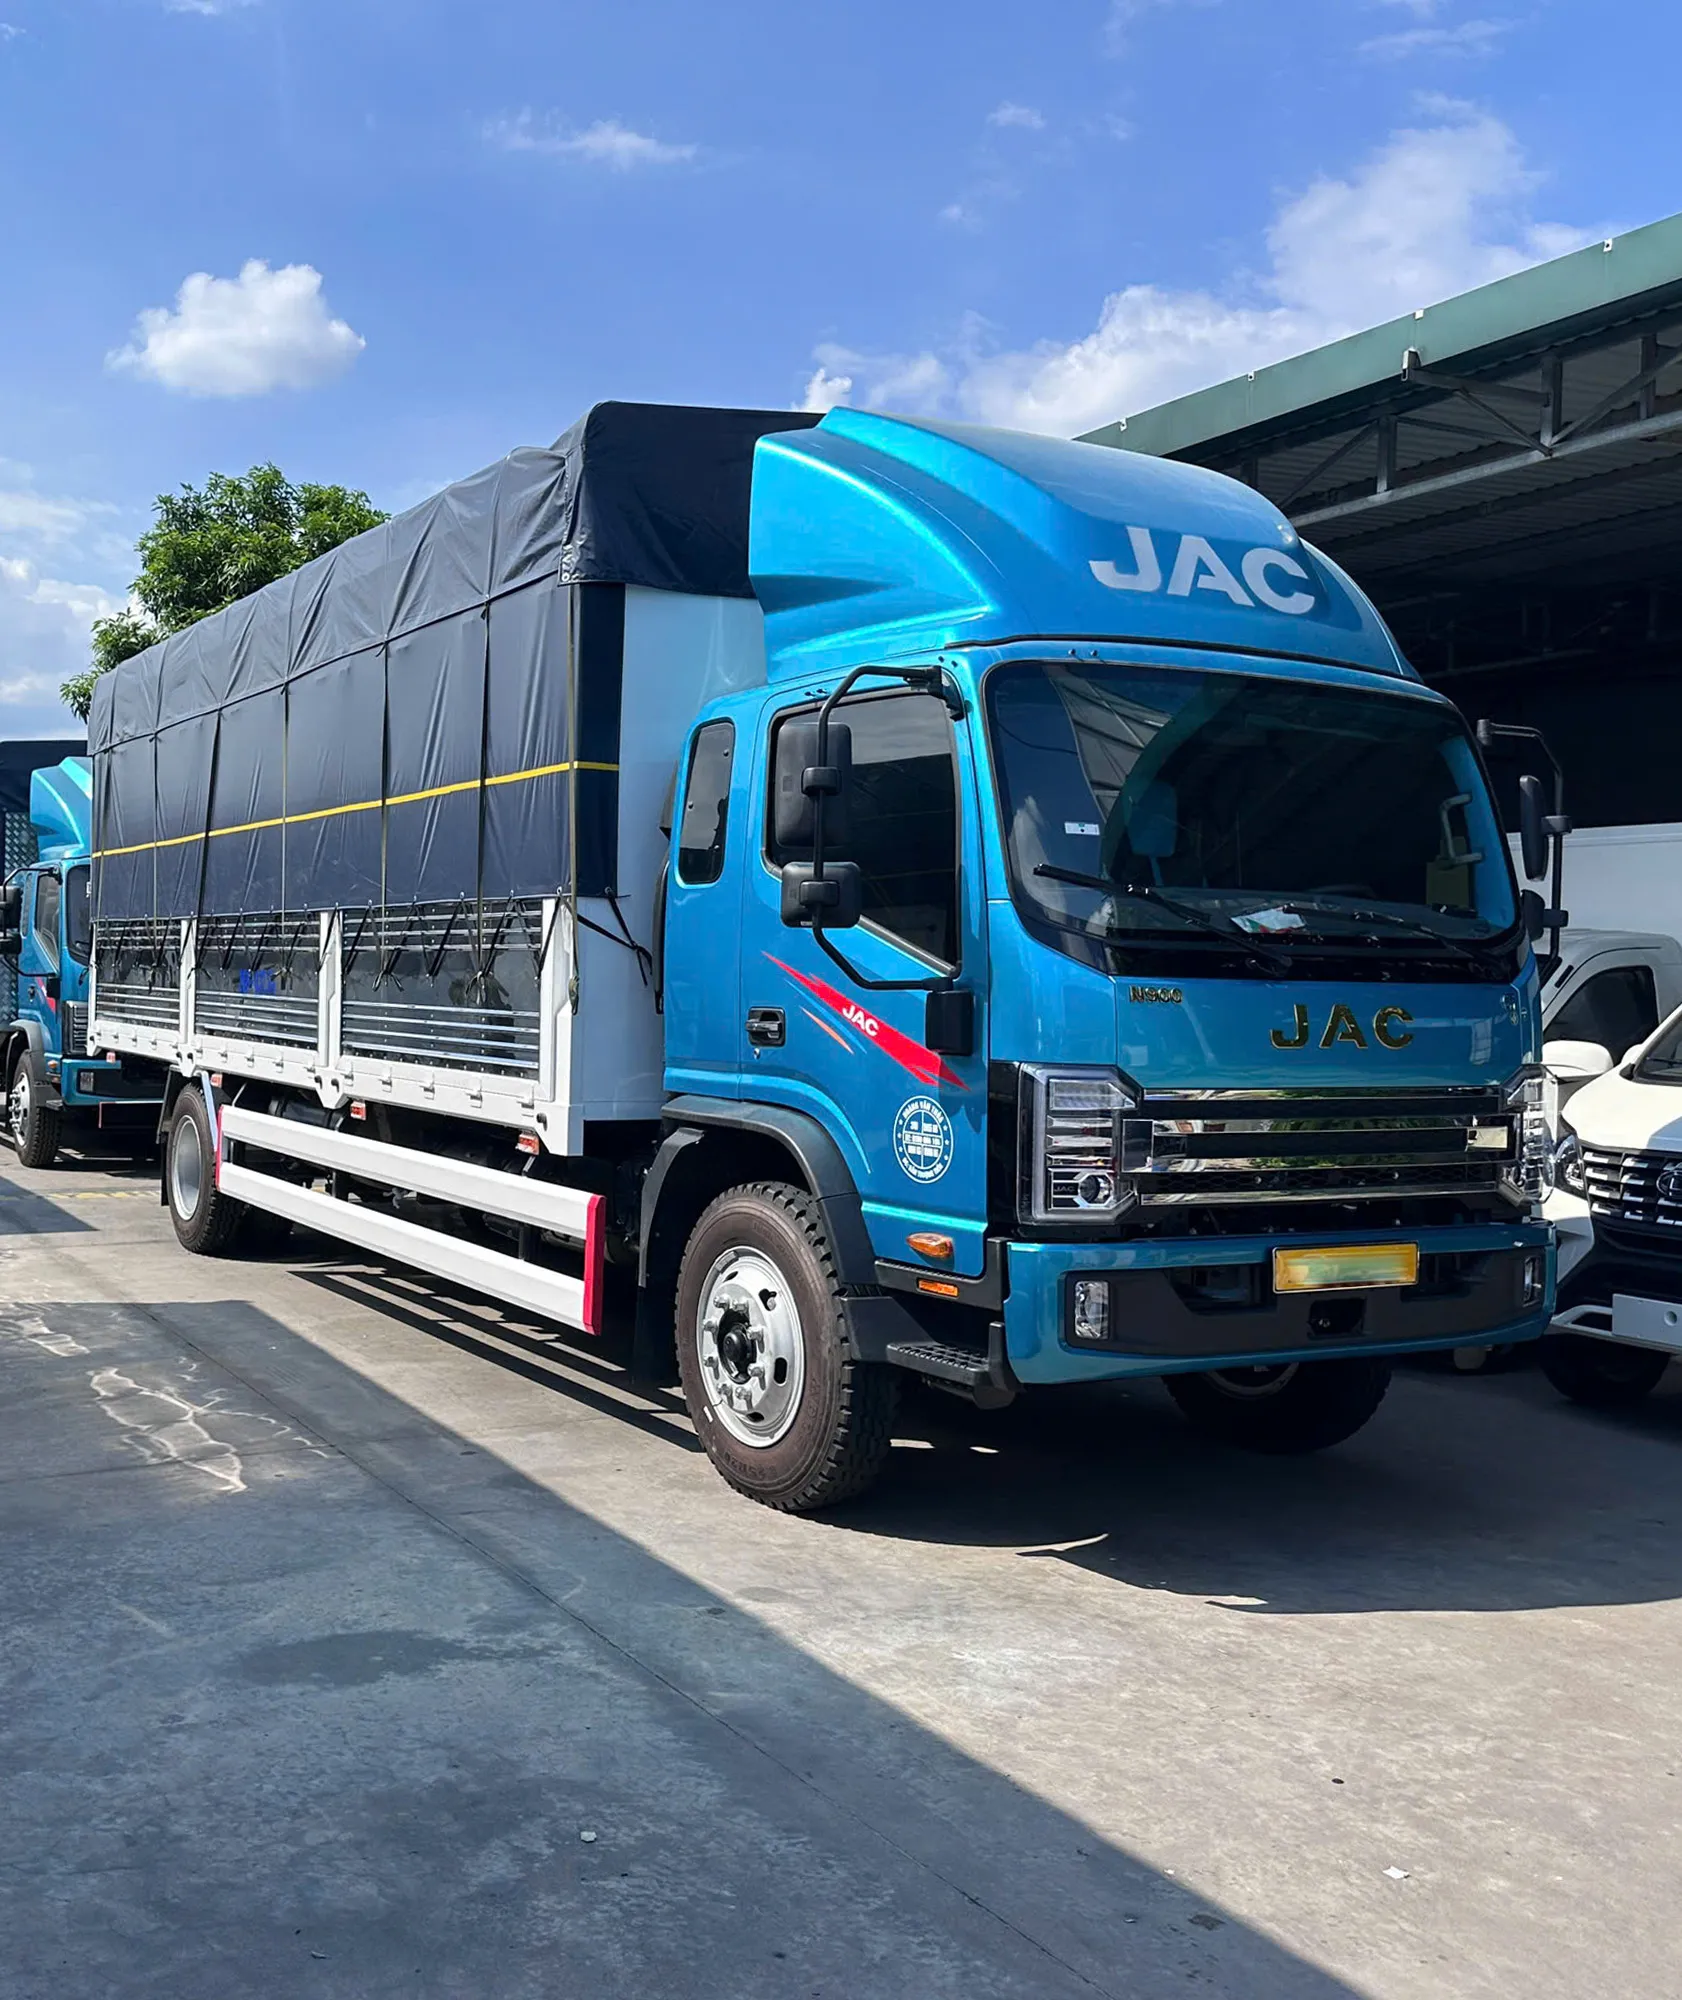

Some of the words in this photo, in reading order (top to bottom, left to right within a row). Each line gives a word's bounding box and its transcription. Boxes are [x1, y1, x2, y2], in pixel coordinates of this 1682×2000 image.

[1089, 526, 1316, 616] JAC
[1129, 985, 1182, 1003] N900
[842, 1005, 879, 1037] JAC
[1270, 1003, 1414, 1050] JAC
